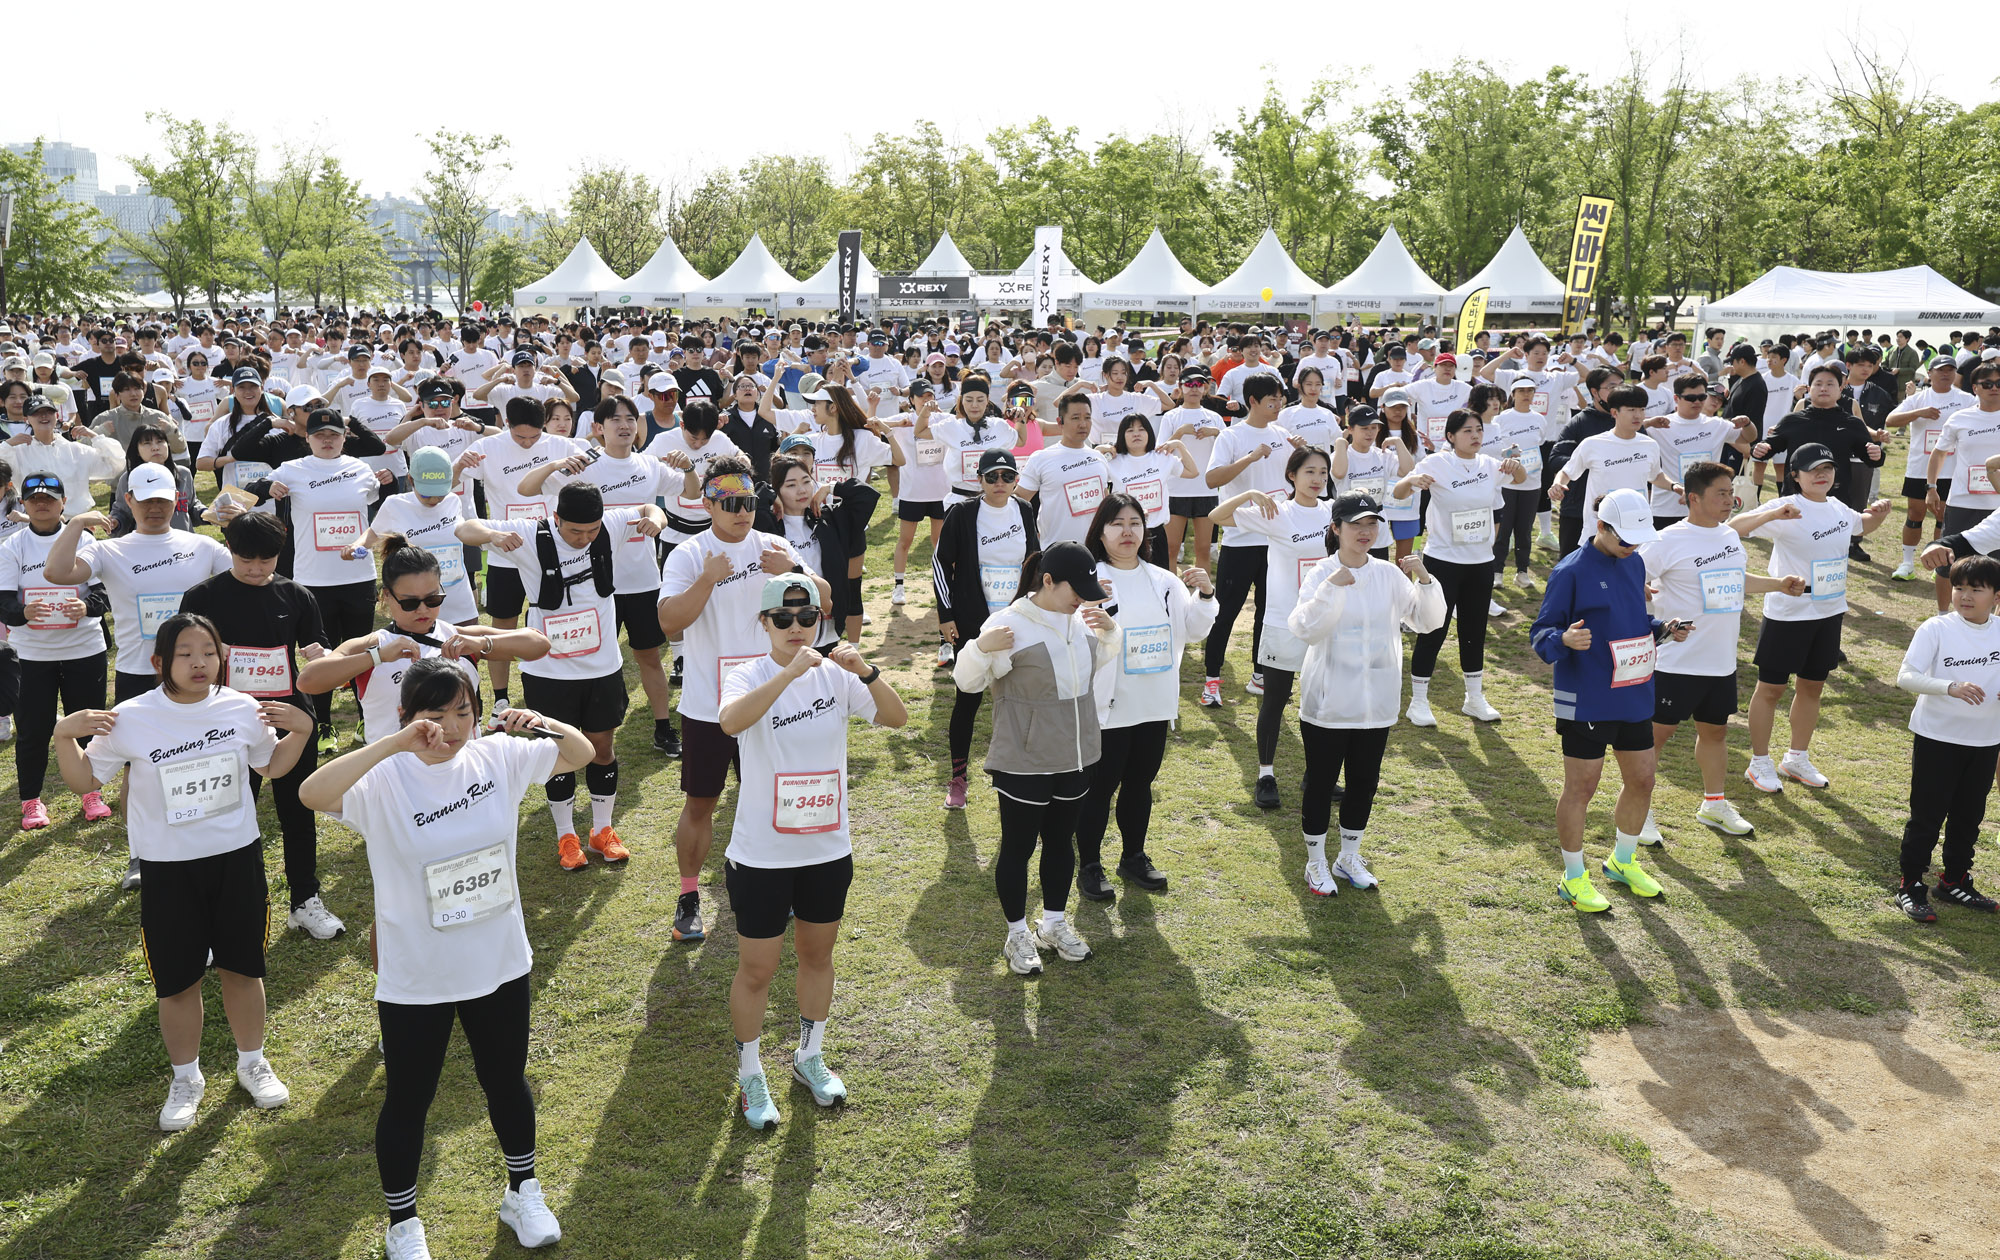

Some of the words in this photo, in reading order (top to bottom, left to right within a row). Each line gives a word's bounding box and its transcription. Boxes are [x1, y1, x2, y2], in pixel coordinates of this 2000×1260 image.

[844, 247, 852, 288] REXY
[1042, 244, 1051, 286] REXY
[917, 284, 948, 292] REXY
[367, 414, 388, 423] Burning
[1102, 409, 1123, 417] Burning
[1297, 421, 1316, 430] Burning
[1968, 428, 1996, 437] Burning
[1674, 437, 1697, 446] Burning
[1698, 431, 1711, 439] Run
[503, 461, 533, 474] Burning
[532, 456, 549, 466] Run
[1061, 460, 1087, 472] Burning
[1086, 456, 1098, 465] Run
[1604, 456, 1633, 467] Burning
[1633, 453, 1648, 462] Run
[309, 476, 341, 489] Burning
[342, 472, 357, 482] Run
[422, 472, 446, 480] HOKA
[1121, 473, 1146, 484] Burning
[1146, 468, 1160, 478] Run
[1348, 470, 1372, 480] Burning
[1451, 478, 1478, 489] Burning
[1478, 472, 1488, 482] Run
[600, 481, 631, 494] Burning
[630, 475, 647, 485] Run
[1079, 488, 1099, 500] 1309
[1138, 491, 1158, 501] 3401
[1, 520, 18, 529] Run
[328, 525, 356, 534] 3403
[406, 524, 441, 538] Burning
[441, 516, 457, 527] Run
[1464, 520, 1486, 531] 6291
[981, 530, 1011, 546] Burning
[1292, 530, 1324, 543] Burning
[1812, 526, 1842, 541] Burning
[131, 556, 173, 574] Burning
[173, 551, 195, 564] Run
[559, 551, 585, 568] urning
[1694, 552, 1727, 568] Burning
[1724, 545, 1740, 557] Run
[22, 560, 46, 574] Burni
[440, 560, 458, 570] 237
[717, 569, 748, 587] Burning
[993, 581, 1018, 590] 8135
[1716, 583, 1742, 594] 7065
[562, 626, 593, 640] 1271
[1140, 641, 1168, 654] 8582
[1629, 651, 1653, 666] 3737
[1943, 657, 1987, 667] Burning
[247, 665, 284, 676] 1945
[772, 709, 814, 730] Burning
[812, 696, 836, 714] Run
[149, 739, 205, 764] Burning
[204, 727, 236, 744] Run
[165, 764, 195, 774] BURNING
[196, 760, 211, 768] RUN
[172, 786, 183, 796] M
[186, 774, 232, 795] 5173
[414, 796, 470, 827] Burning
[467, 779, 495, 798] Run
[796, 794, 834, 809] 3456
[175, 809, 198, 819] D-27
[432, 860, 464, 875] BURNING
[464, 855, 479, 866] RUN
[438, 886, 450, 899] W
[452, 868, 502, 896] 6387
[442, 911, 467, 922] D-30
